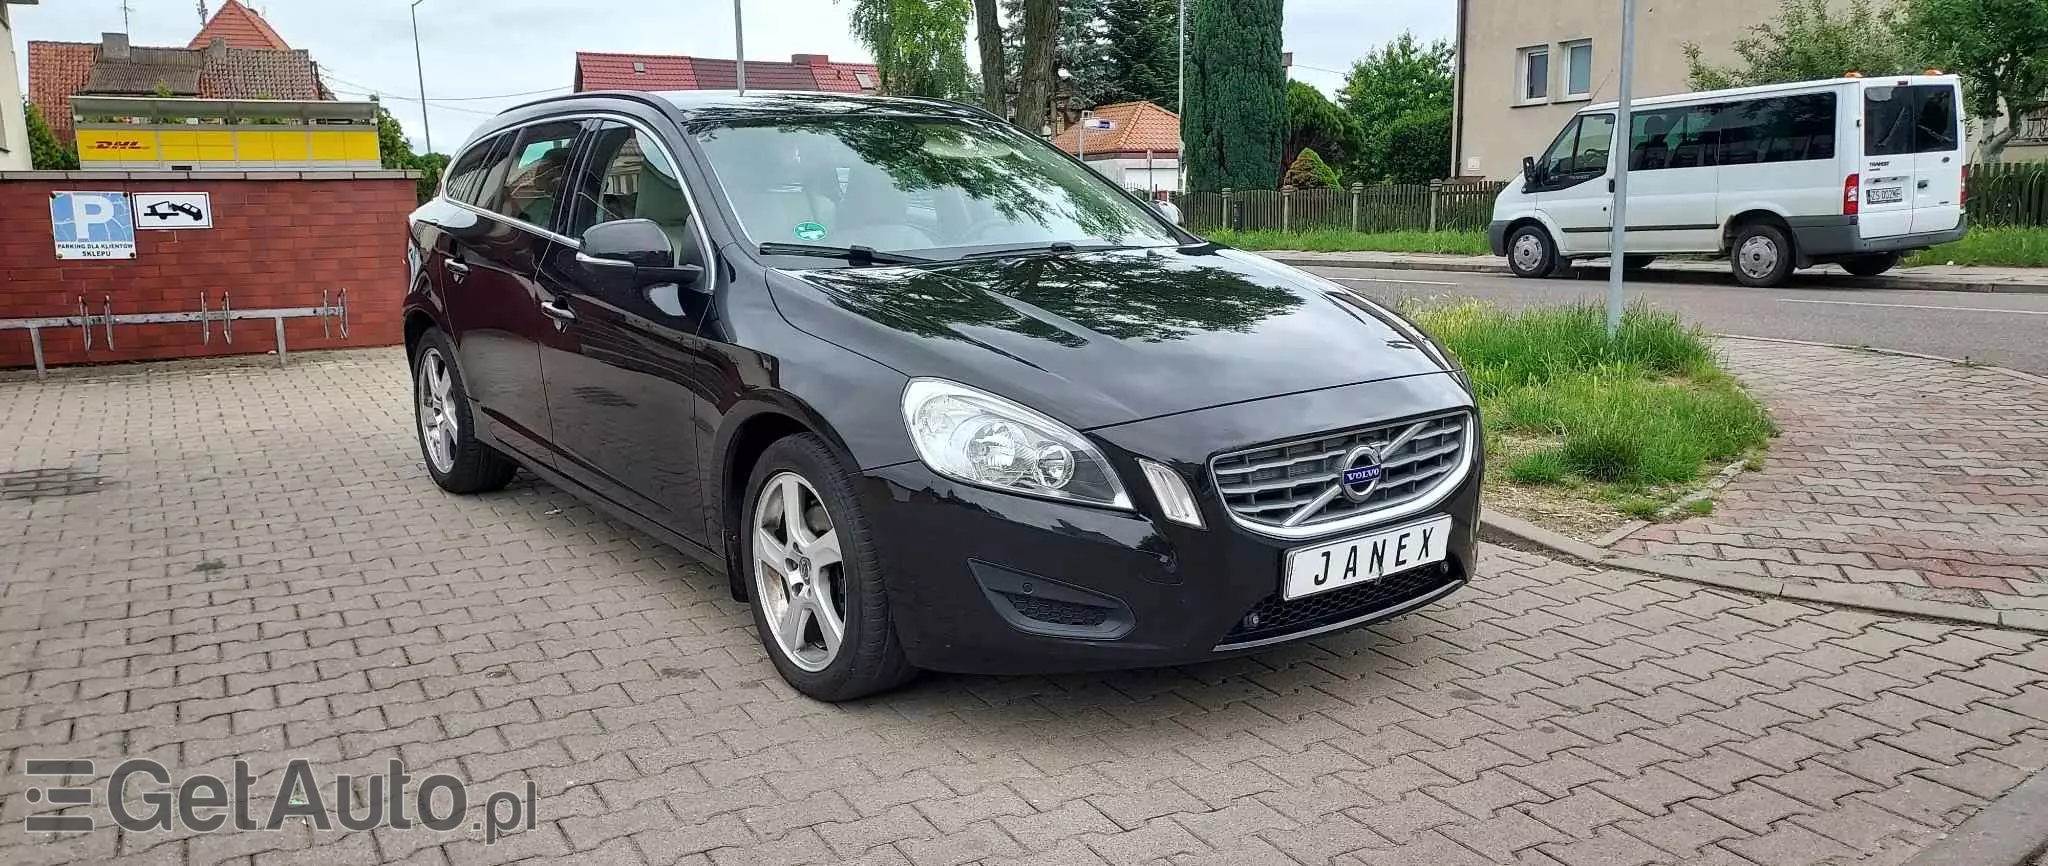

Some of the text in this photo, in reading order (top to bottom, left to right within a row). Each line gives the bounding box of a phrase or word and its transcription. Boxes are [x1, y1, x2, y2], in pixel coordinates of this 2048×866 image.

[95, 141, 142, 149] DHL
[71, 194, 114, 239] P
[1347, 468, 1380, 480] VOLVO
[1314, 526, 1434, 586] JANEX
